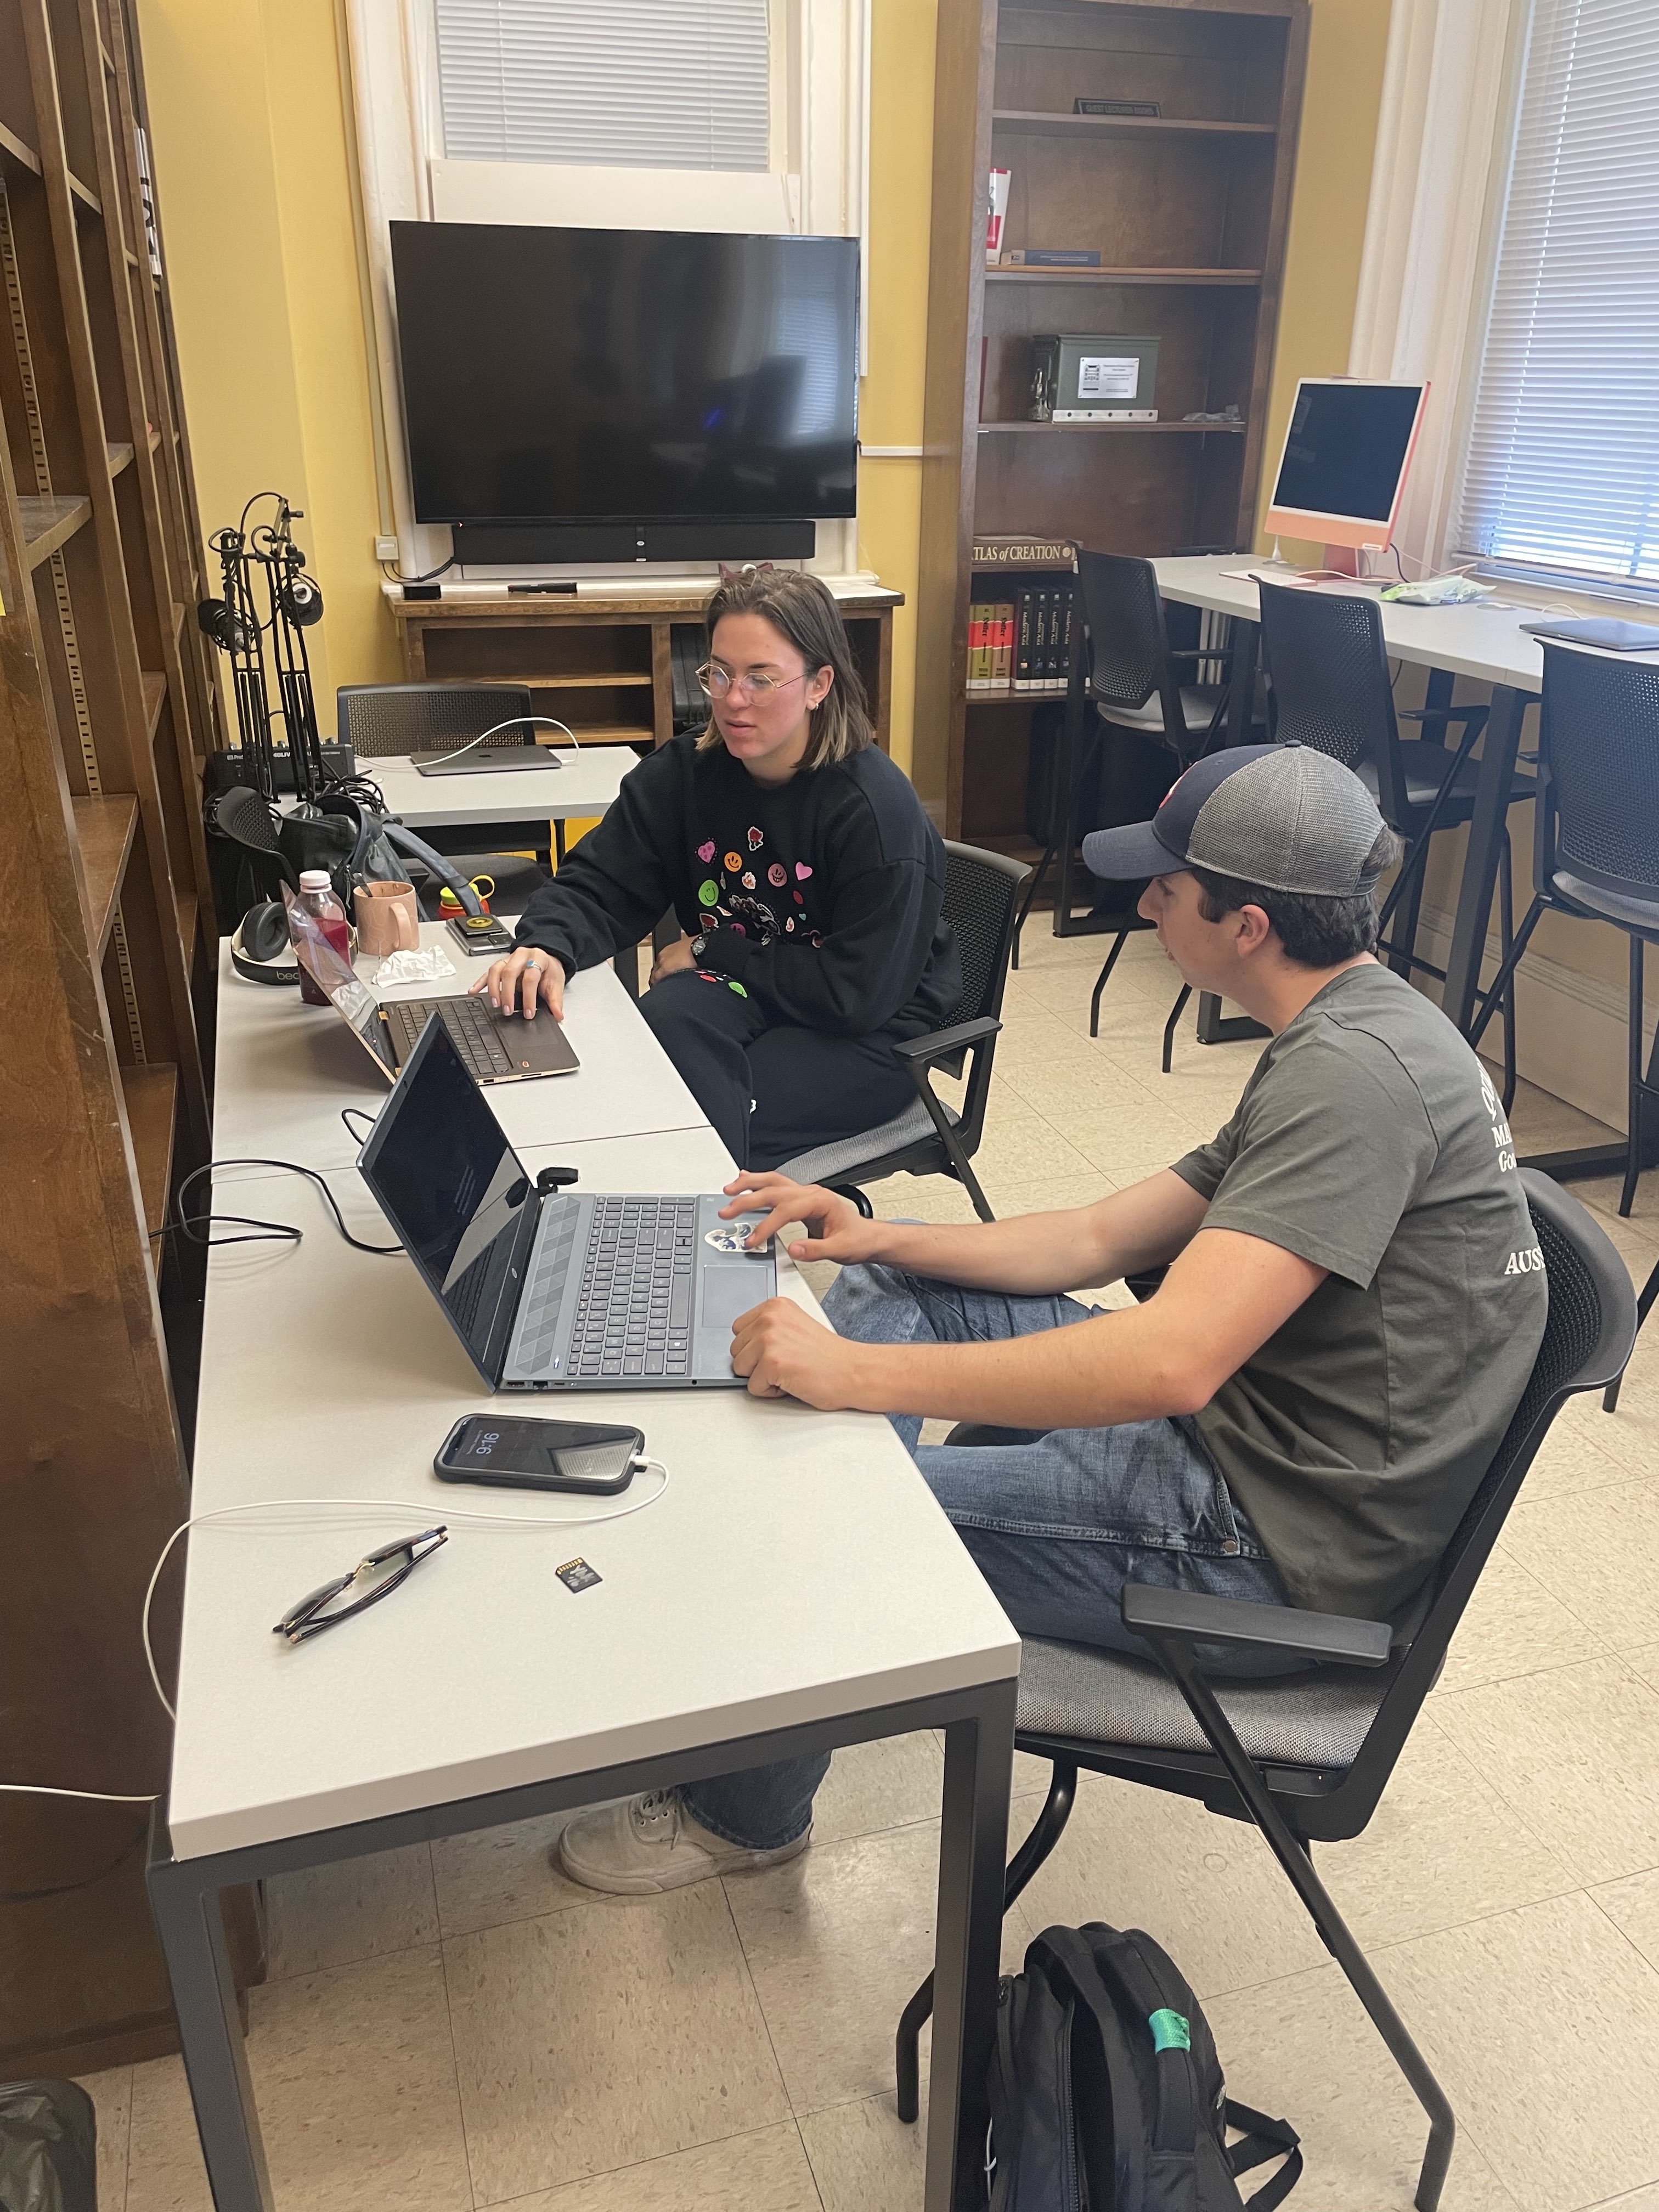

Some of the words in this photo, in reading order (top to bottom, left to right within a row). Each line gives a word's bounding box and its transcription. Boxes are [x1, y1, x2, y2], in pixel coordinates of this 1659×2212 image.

[972, 546, 997, 560] TLAS
[999, 547, 1010, 562] of
[1009, 546, 1060, 560] CREATION
[476, 1432, 500, 1454] 9:16
